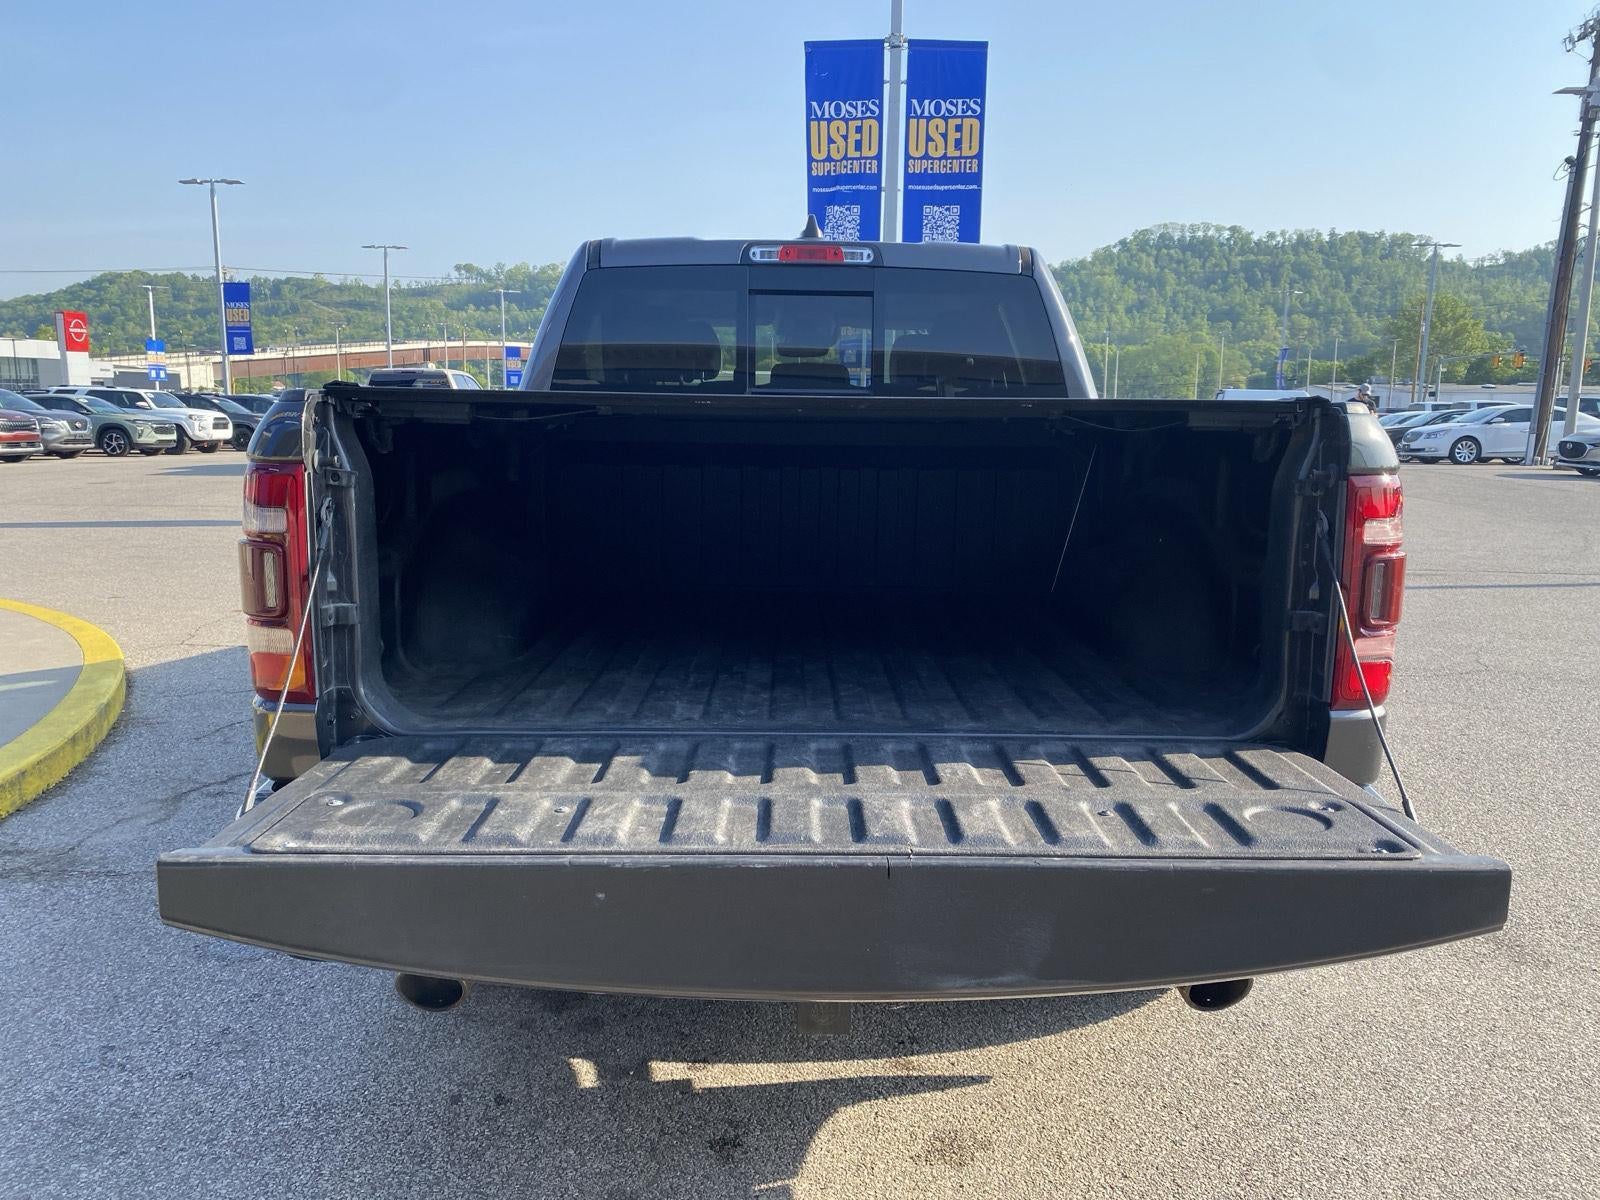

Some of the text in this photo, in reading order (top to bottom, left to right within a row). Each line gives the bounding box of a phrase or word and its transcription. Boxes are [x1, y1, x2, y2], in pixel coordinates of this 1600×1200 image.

[810, 99, 880, 119] MOSES
[909, 98, 981, 117] MOSES
[810, 118, 880, 160] USED
[908, 118, 981, 158] USED
[811, 160, 878, 176] SUPERCENTER
[908, 159, 978, 174] SUPERCENTER
[226, 309, 250, 322] USED
